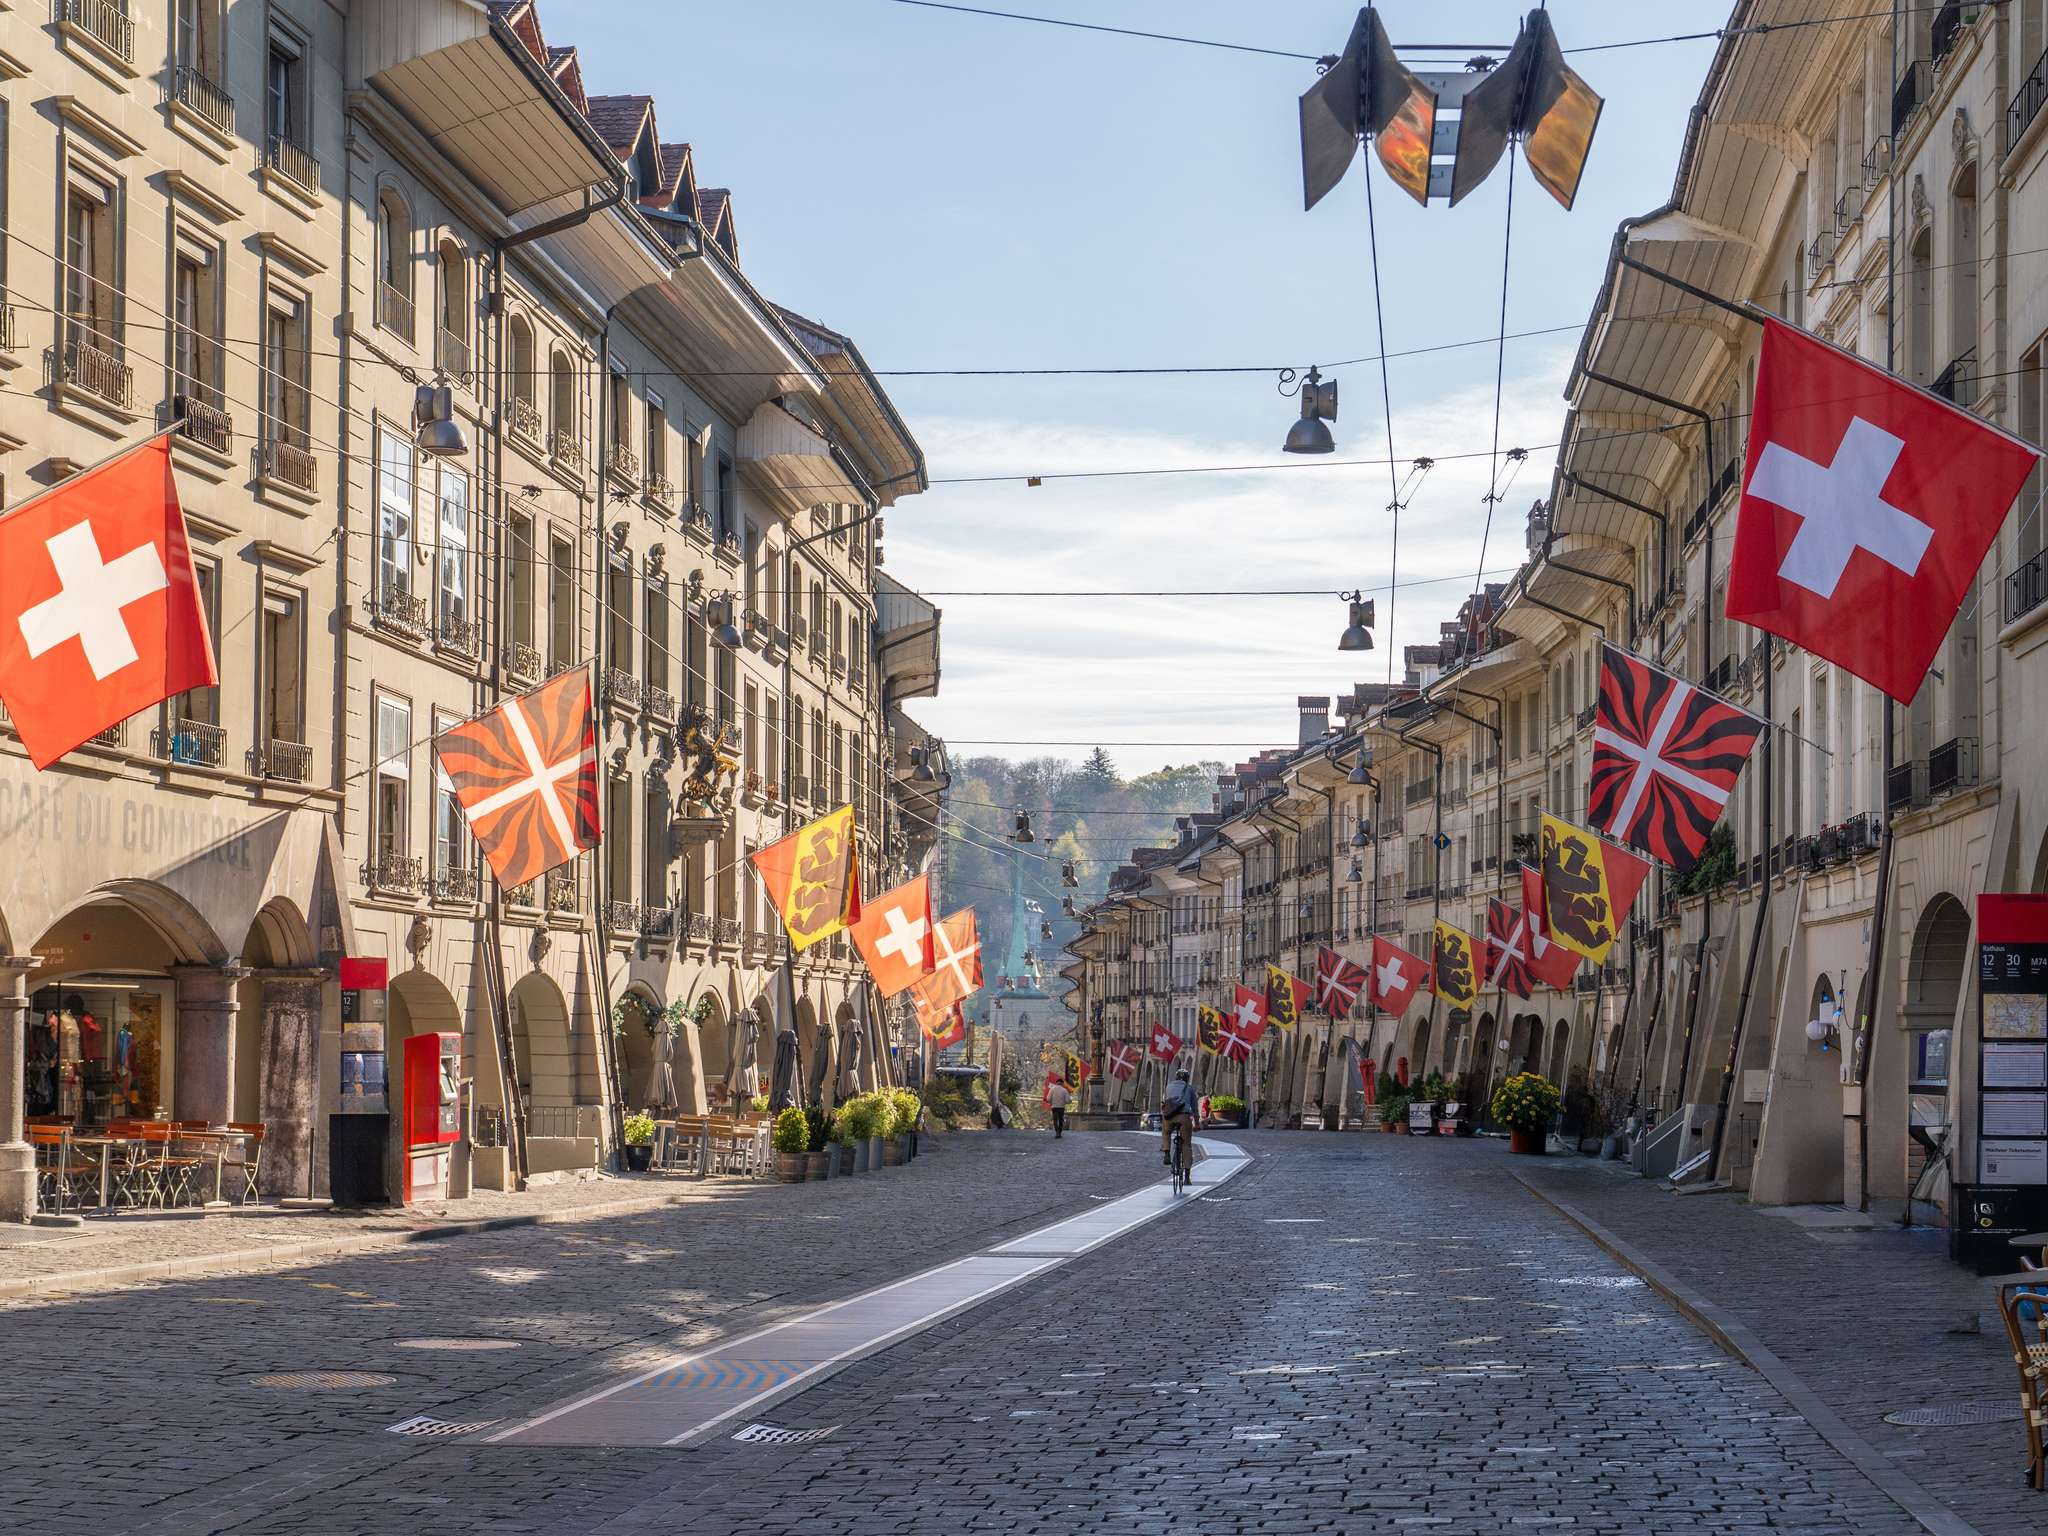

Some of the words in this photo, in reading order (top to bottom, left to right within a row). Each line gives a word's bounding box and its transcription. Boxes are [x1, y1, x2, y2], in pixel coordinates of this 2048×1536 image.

[76, 791, 111, 849] DU
[122, 799, 251, 869] COMMERCE
[1982, 954, 1995, 966] 12
[2006, 954, 2021, 966] 30
[2031, 957, 2048, 966] M74
[343, 997, 351, 1005] 12
